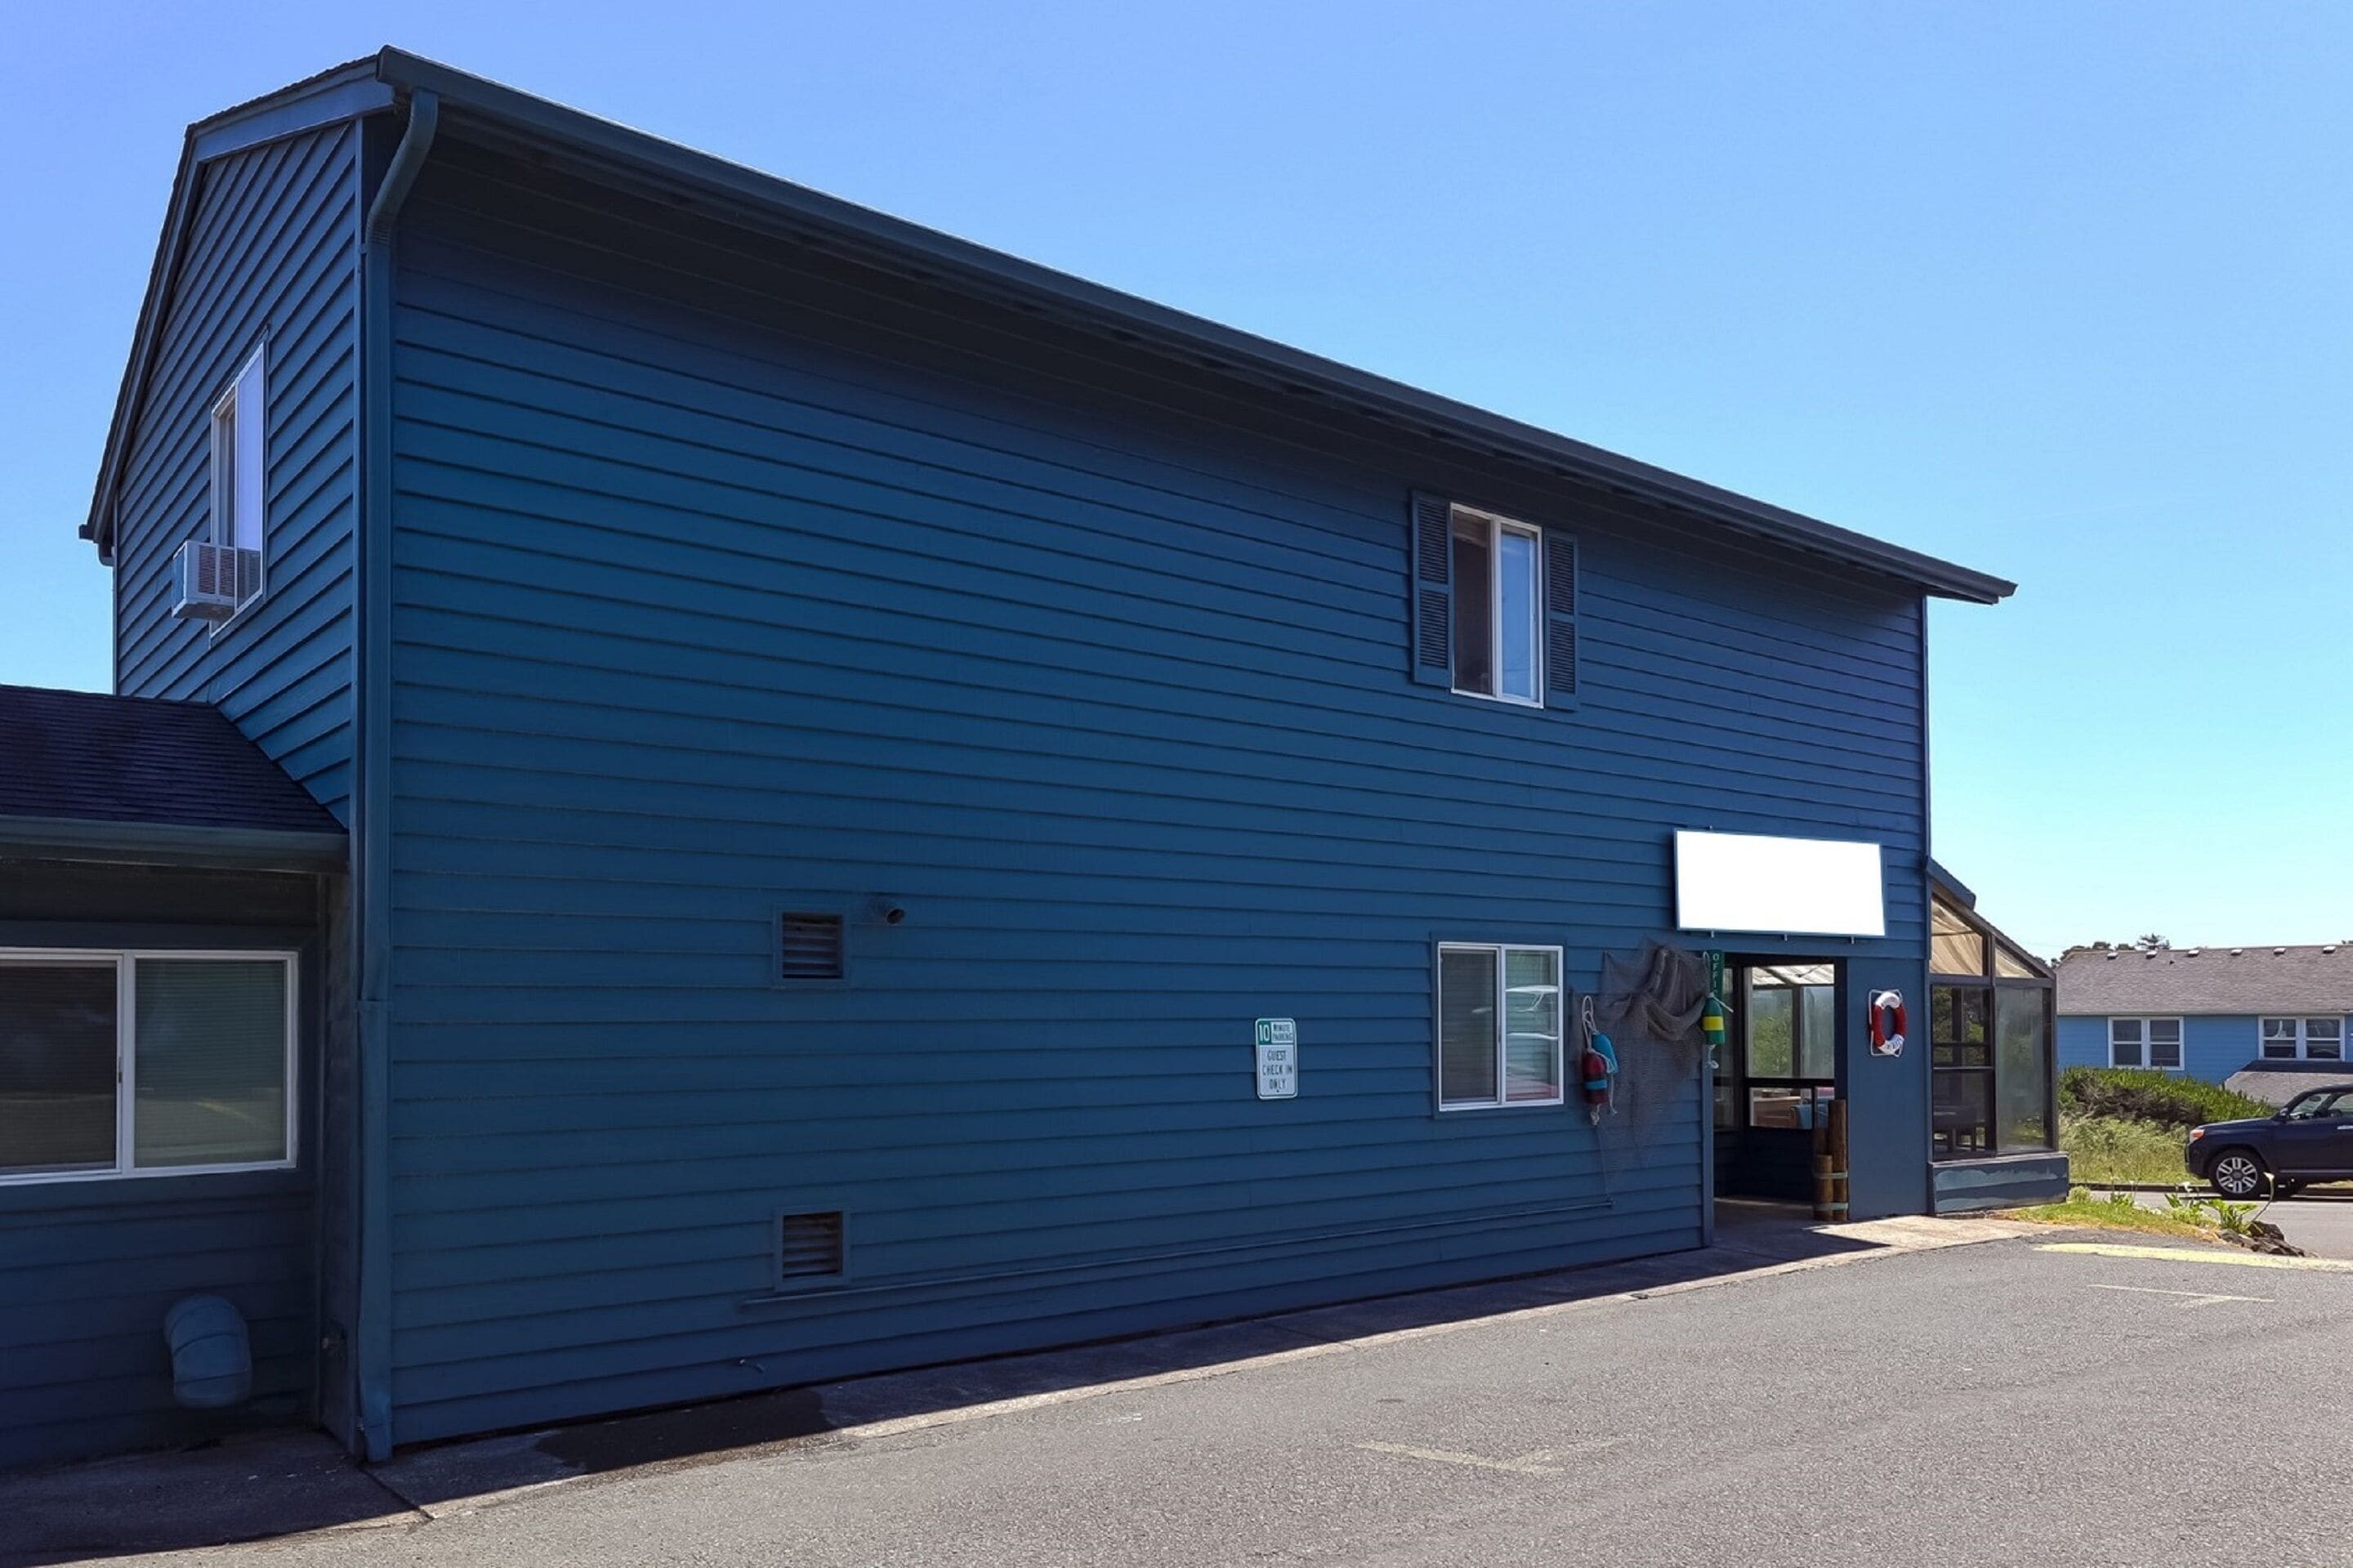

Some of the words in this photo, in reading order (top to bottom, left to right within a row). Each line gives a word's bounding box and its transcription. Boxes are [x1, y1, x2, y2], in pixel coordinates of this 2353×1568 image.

[1258, 1024, 1270, 1041] 10
[1267, 1050, 1287, 1061] GUEST
[1262, 1064, 1283, 1075] CHECK
[1284, 1065, 1293, 1074] IN
[1269, 1079, 1286, 1089] ONLY
